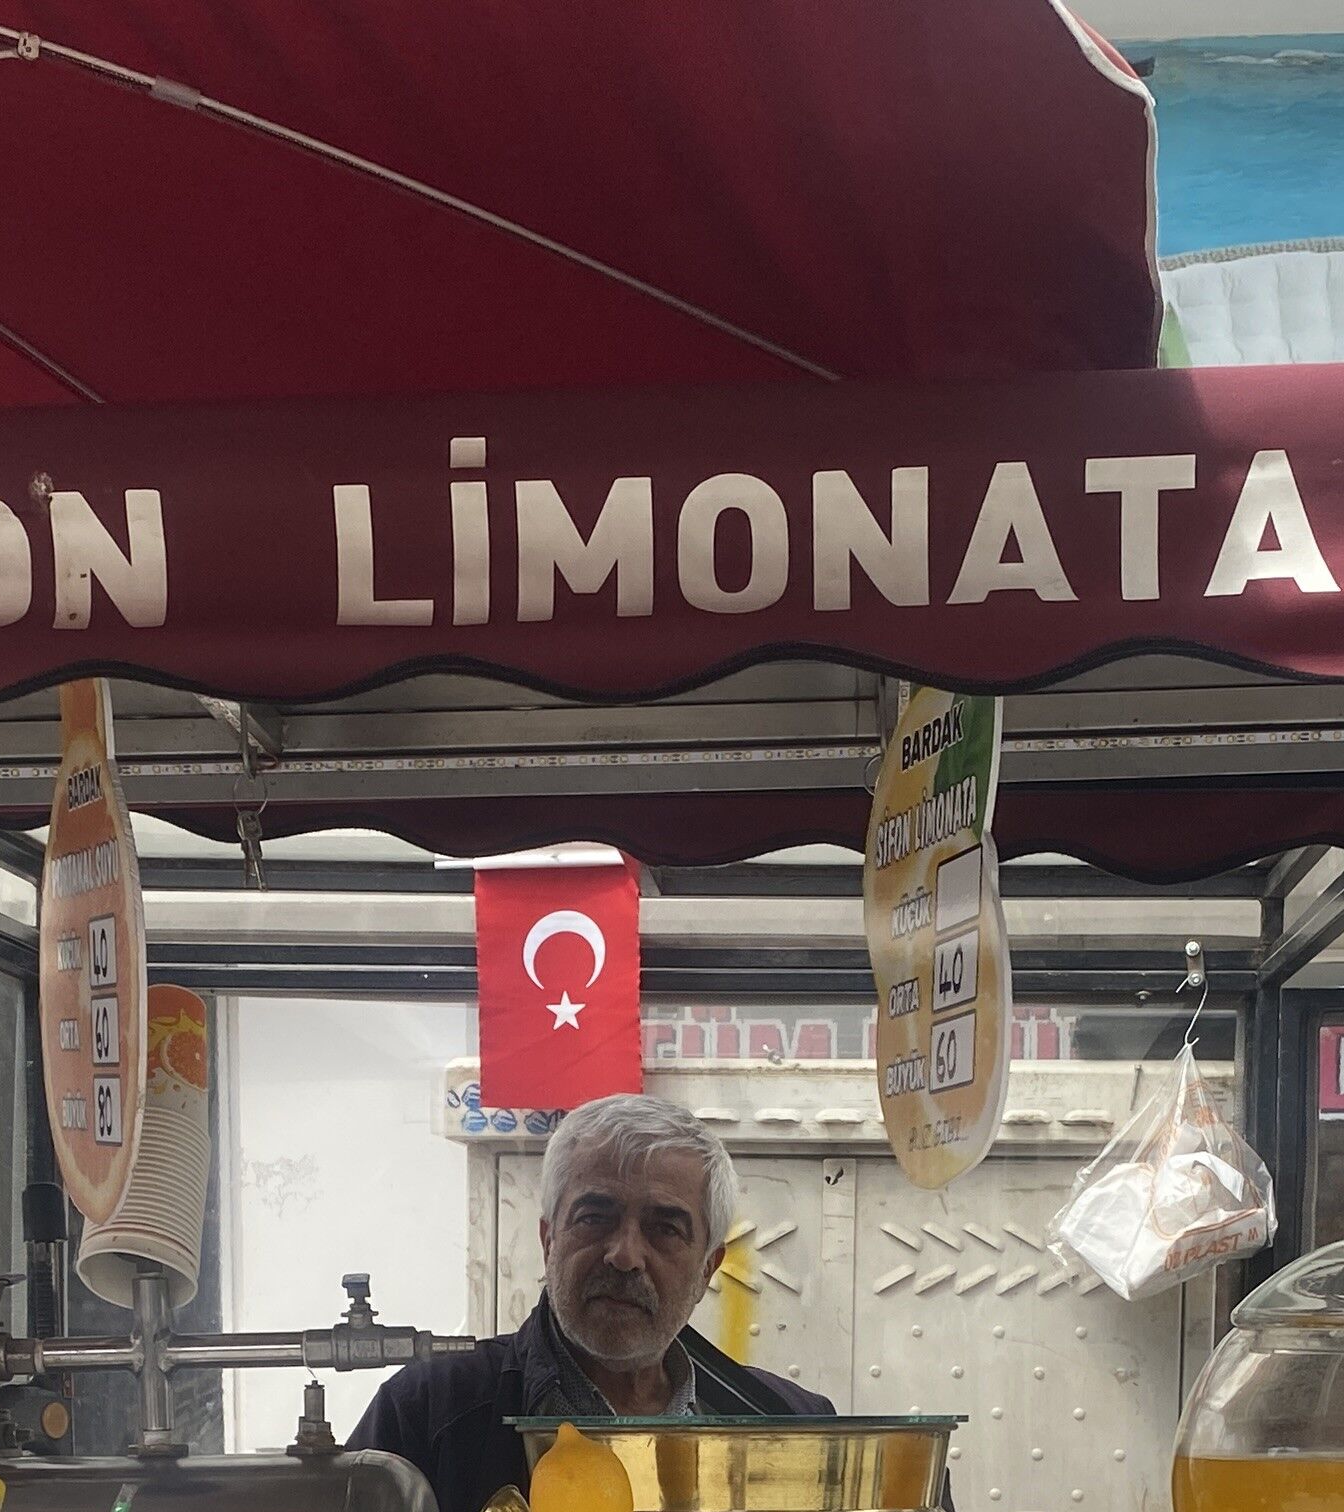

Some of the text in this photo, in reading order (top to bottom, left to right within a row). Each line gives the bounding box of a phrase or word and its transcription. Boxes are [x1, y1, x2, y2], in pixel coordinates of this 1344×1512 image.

[333, 437, 1341, 627] LİMONATA
[901, 700, 963, 772] BARDAK
[67, 762, 103, 812] BARDAK
[876, 775, 977, 870] SİFON LİMONATA
[889, 977, 919, 1019] ORTA
[939, 949, 963, 1001] 40
[885, 1048, 927, 1098] BÜYÜK
[937, 1029, 957, 1083] 60
[97, 1085, 112, 1136] 80
